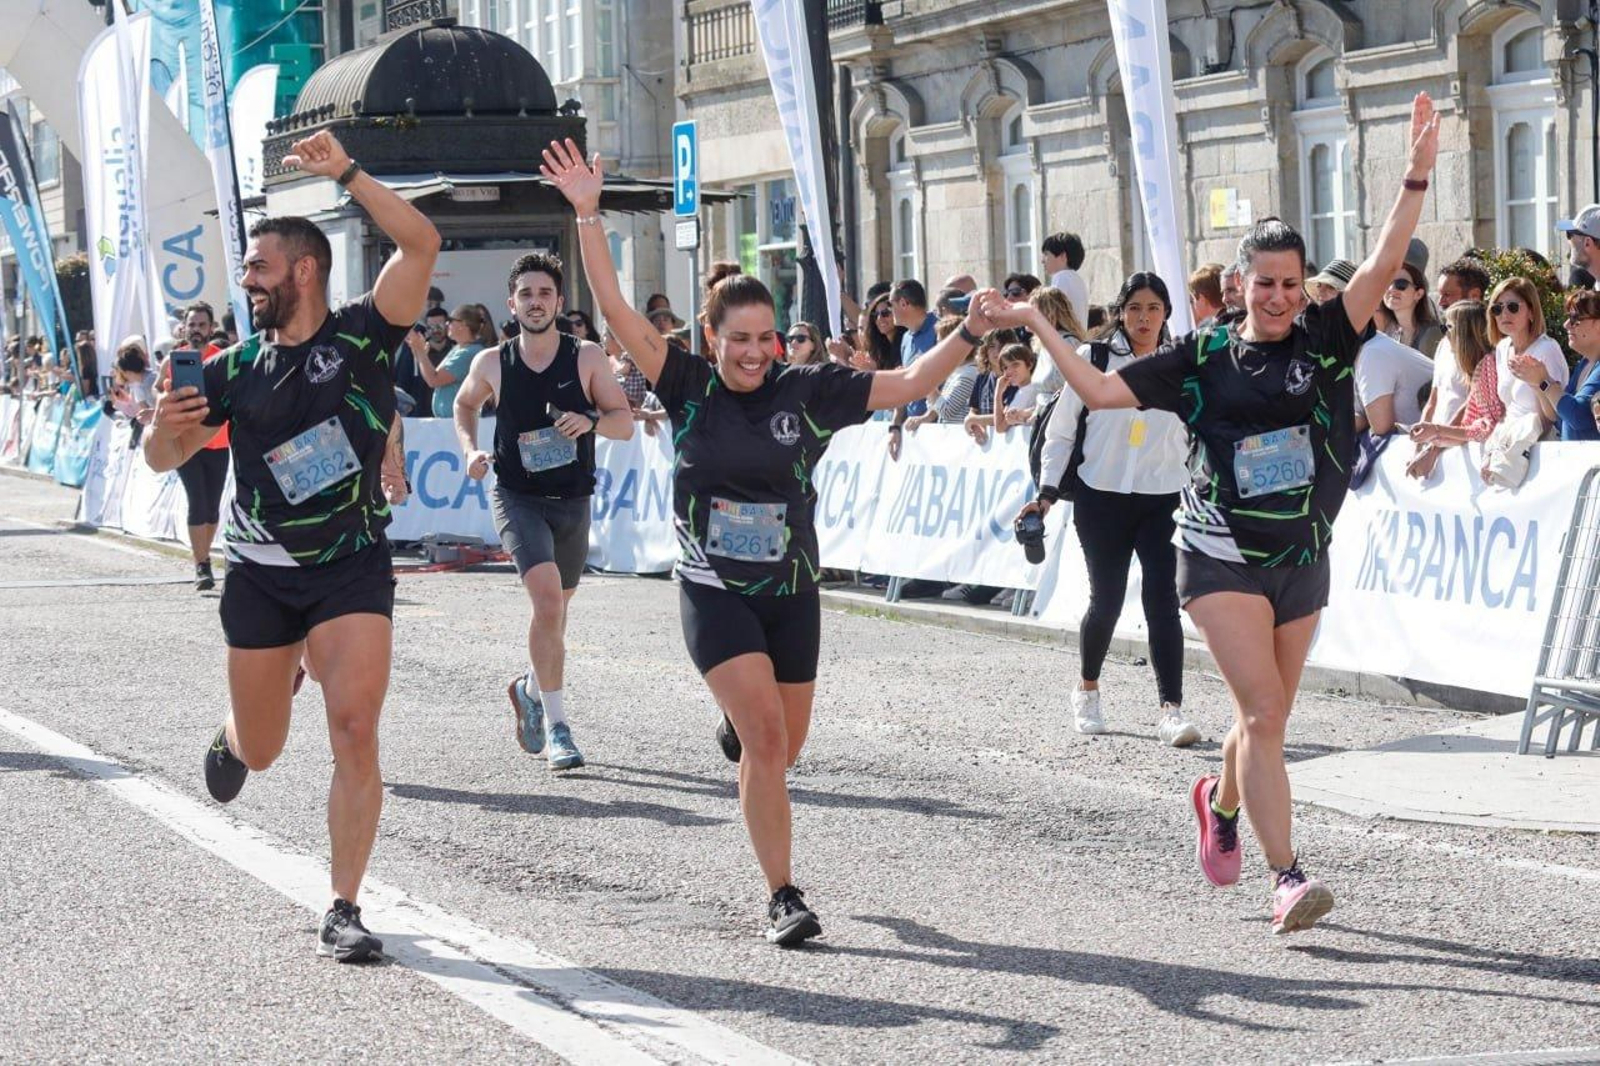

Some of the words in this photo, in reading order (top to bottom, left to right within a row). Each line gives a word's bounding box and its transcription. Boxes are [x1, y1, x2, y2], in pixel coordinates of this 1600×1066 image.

[677, 134, 692, 205] P
[162, 224, 204, 315] CA
[295, 450, 346, 491] 5262
[534, 445, 572, 467] 5438
[1252, 459, 1306, 488] 5260
[722, 531, 772, 555] 5261
